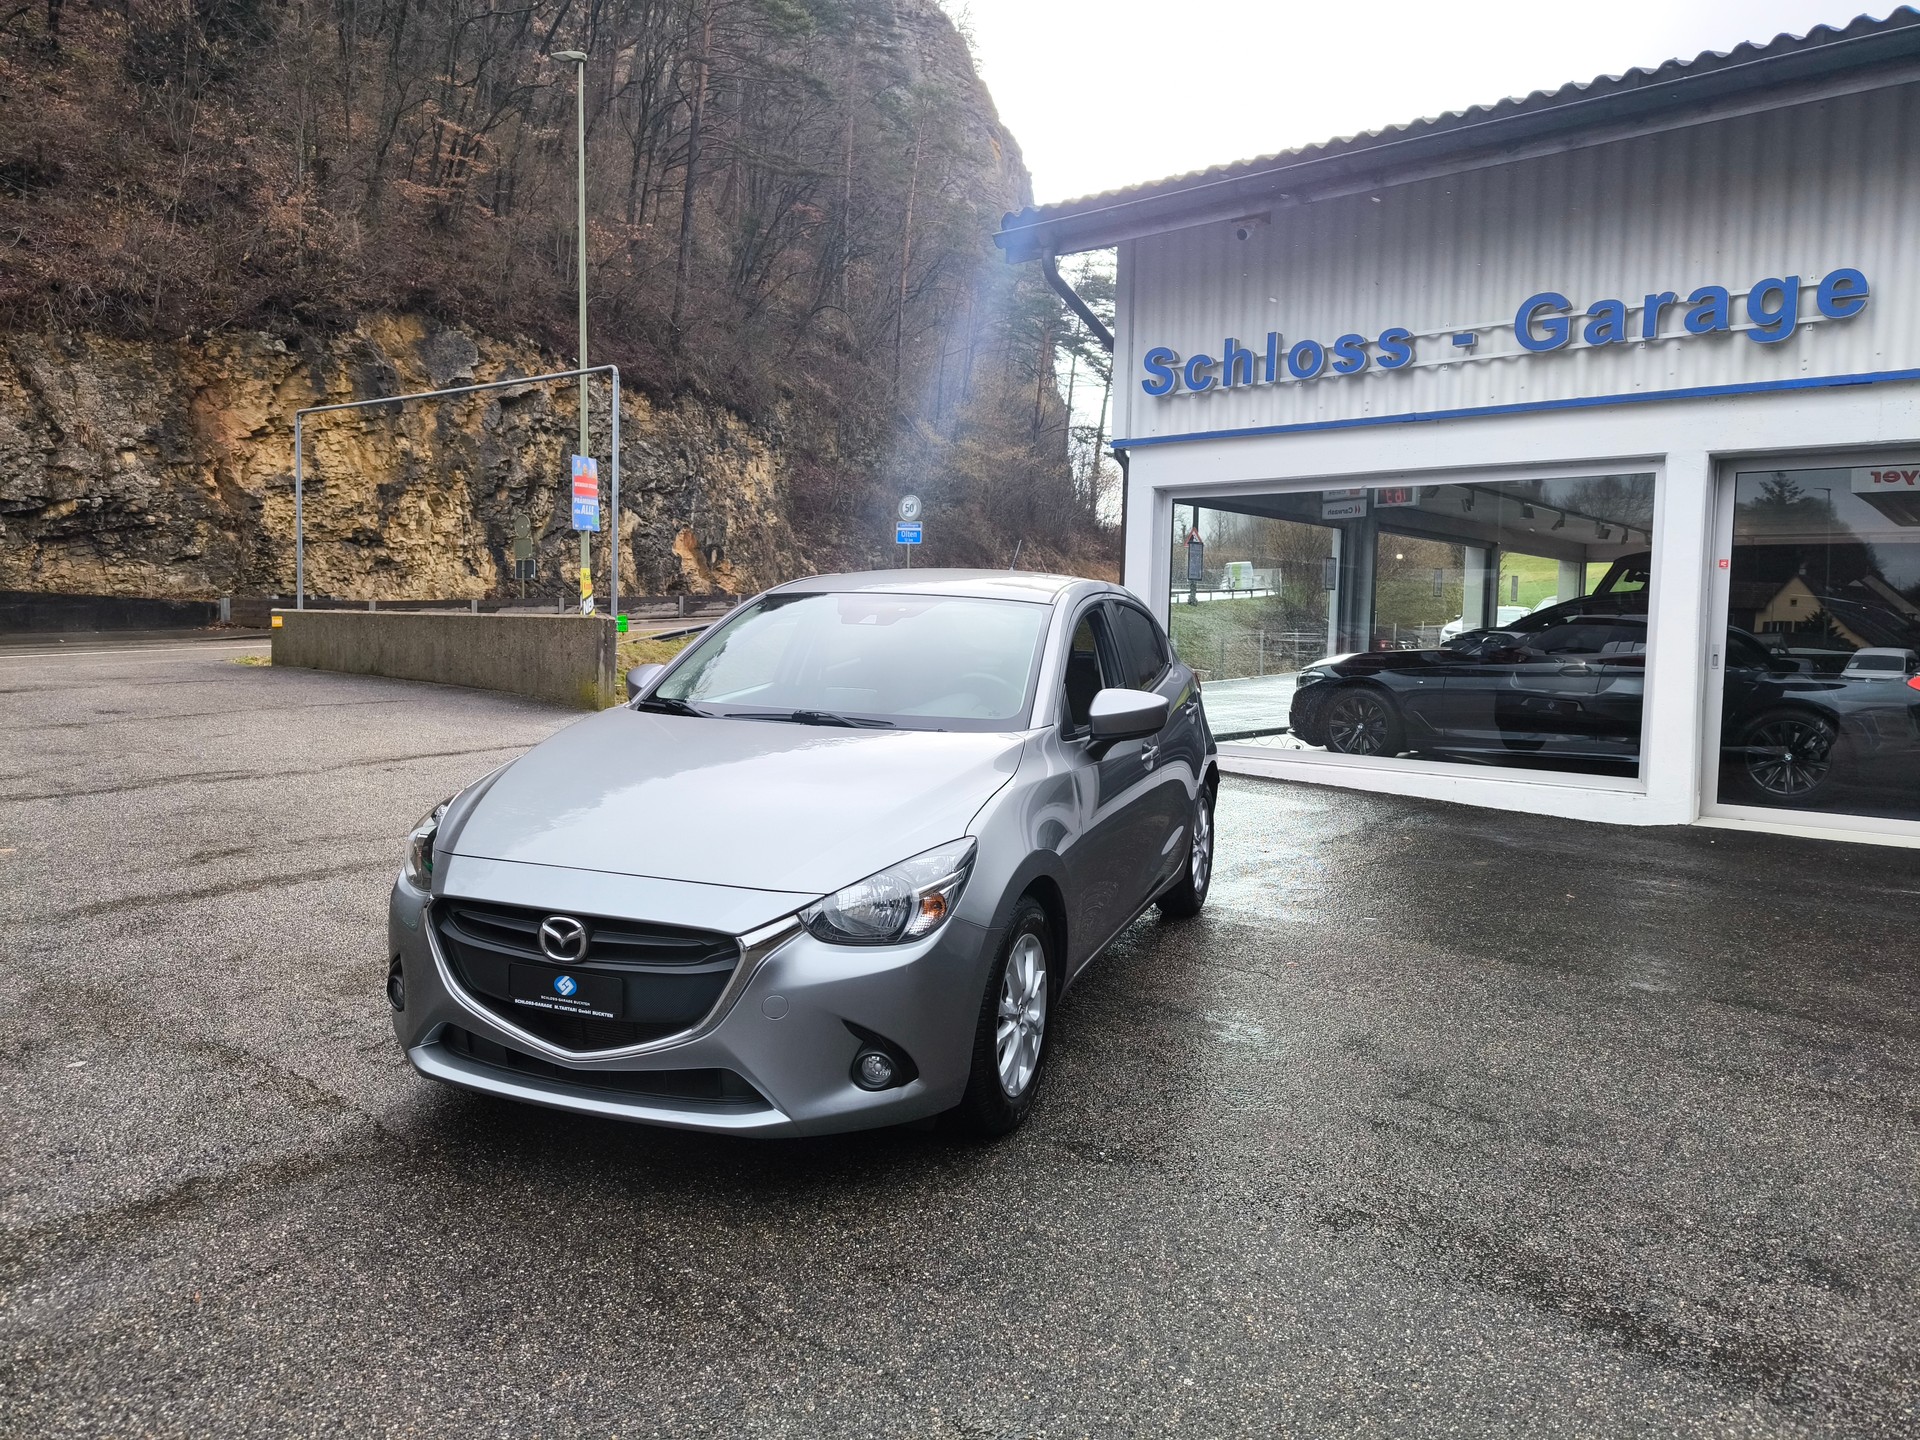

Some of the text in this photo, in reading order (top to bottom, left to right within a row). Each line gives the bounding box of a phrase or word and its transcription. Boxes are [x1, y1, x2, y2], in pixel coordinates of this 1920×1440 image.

[1141, 268, 1870, 396] Schloss - Garage
[905, 504, 914, 512] 50
[515, 998, 552, 1008] SCHLOSS-GARAGE
[540, 995, 573, 1004] SCHLOSS-GARAGE
